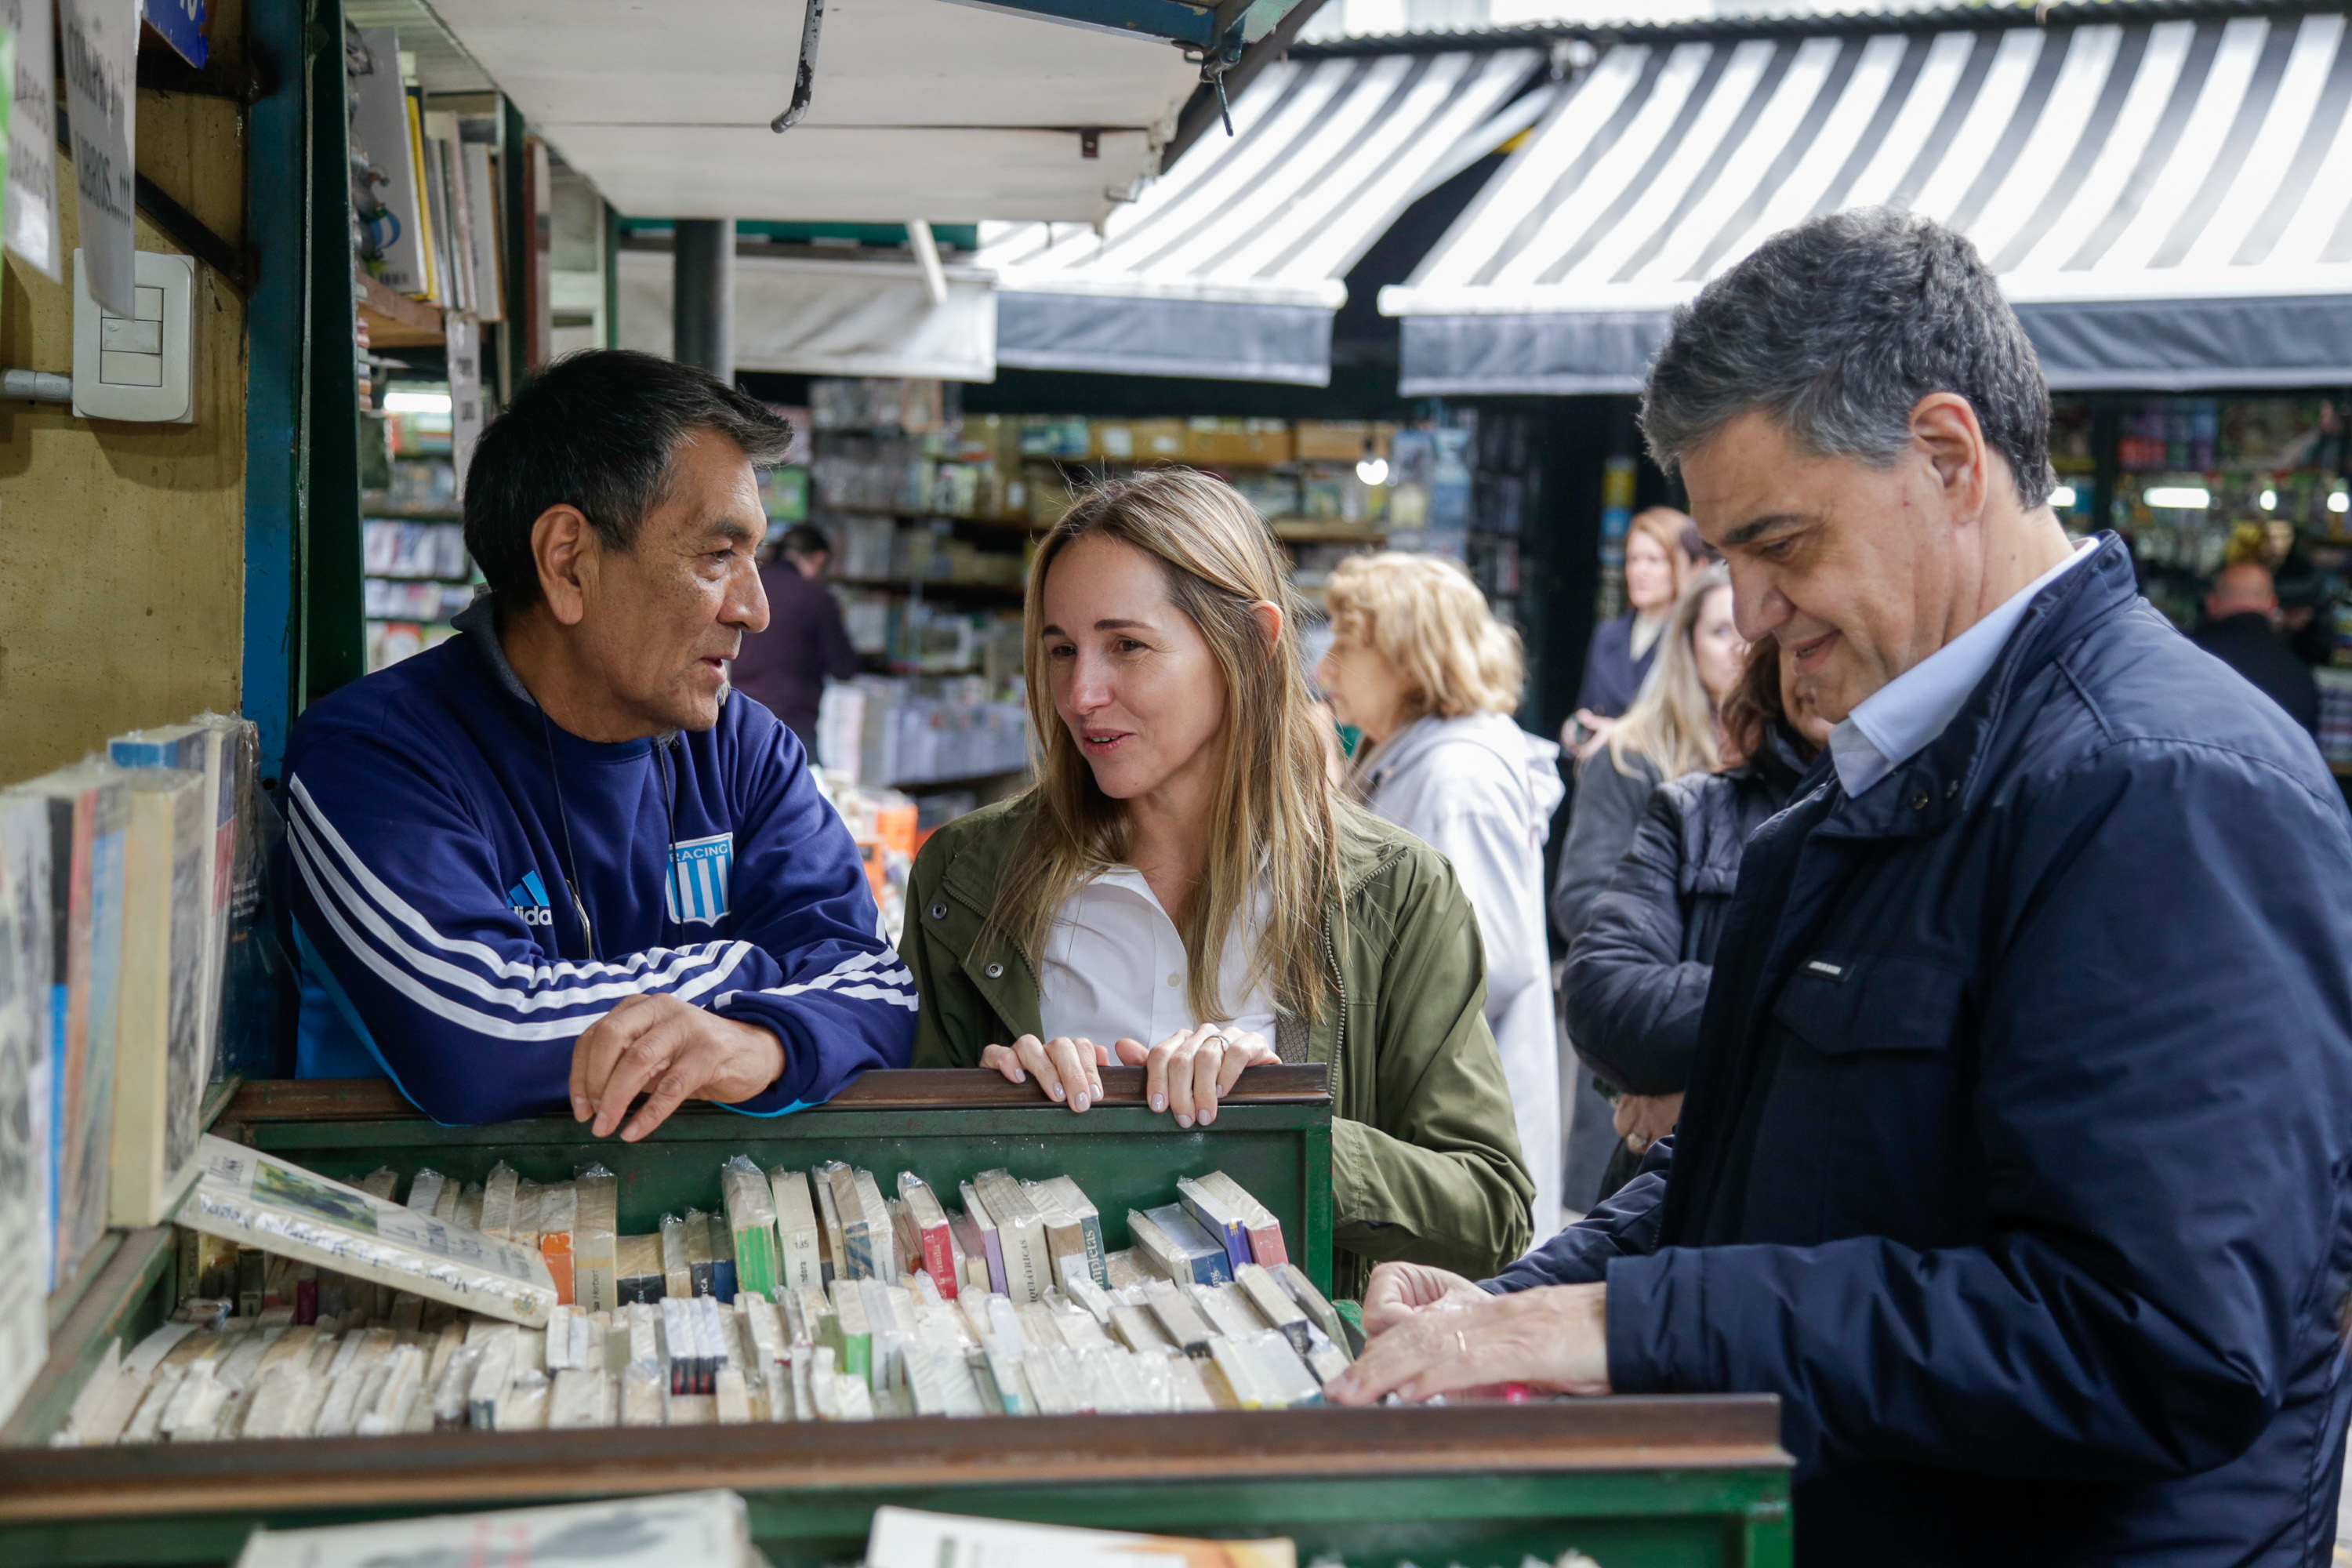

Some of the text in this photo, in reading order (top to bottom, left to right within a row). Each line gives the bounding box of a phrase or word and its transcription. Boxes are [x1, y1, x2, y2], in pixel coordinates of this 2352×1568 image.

[669, 844, 728, 862] RACING
[794, 1240, 809, 1250] 135
[591, 1269, 600, 1300] Herbert
